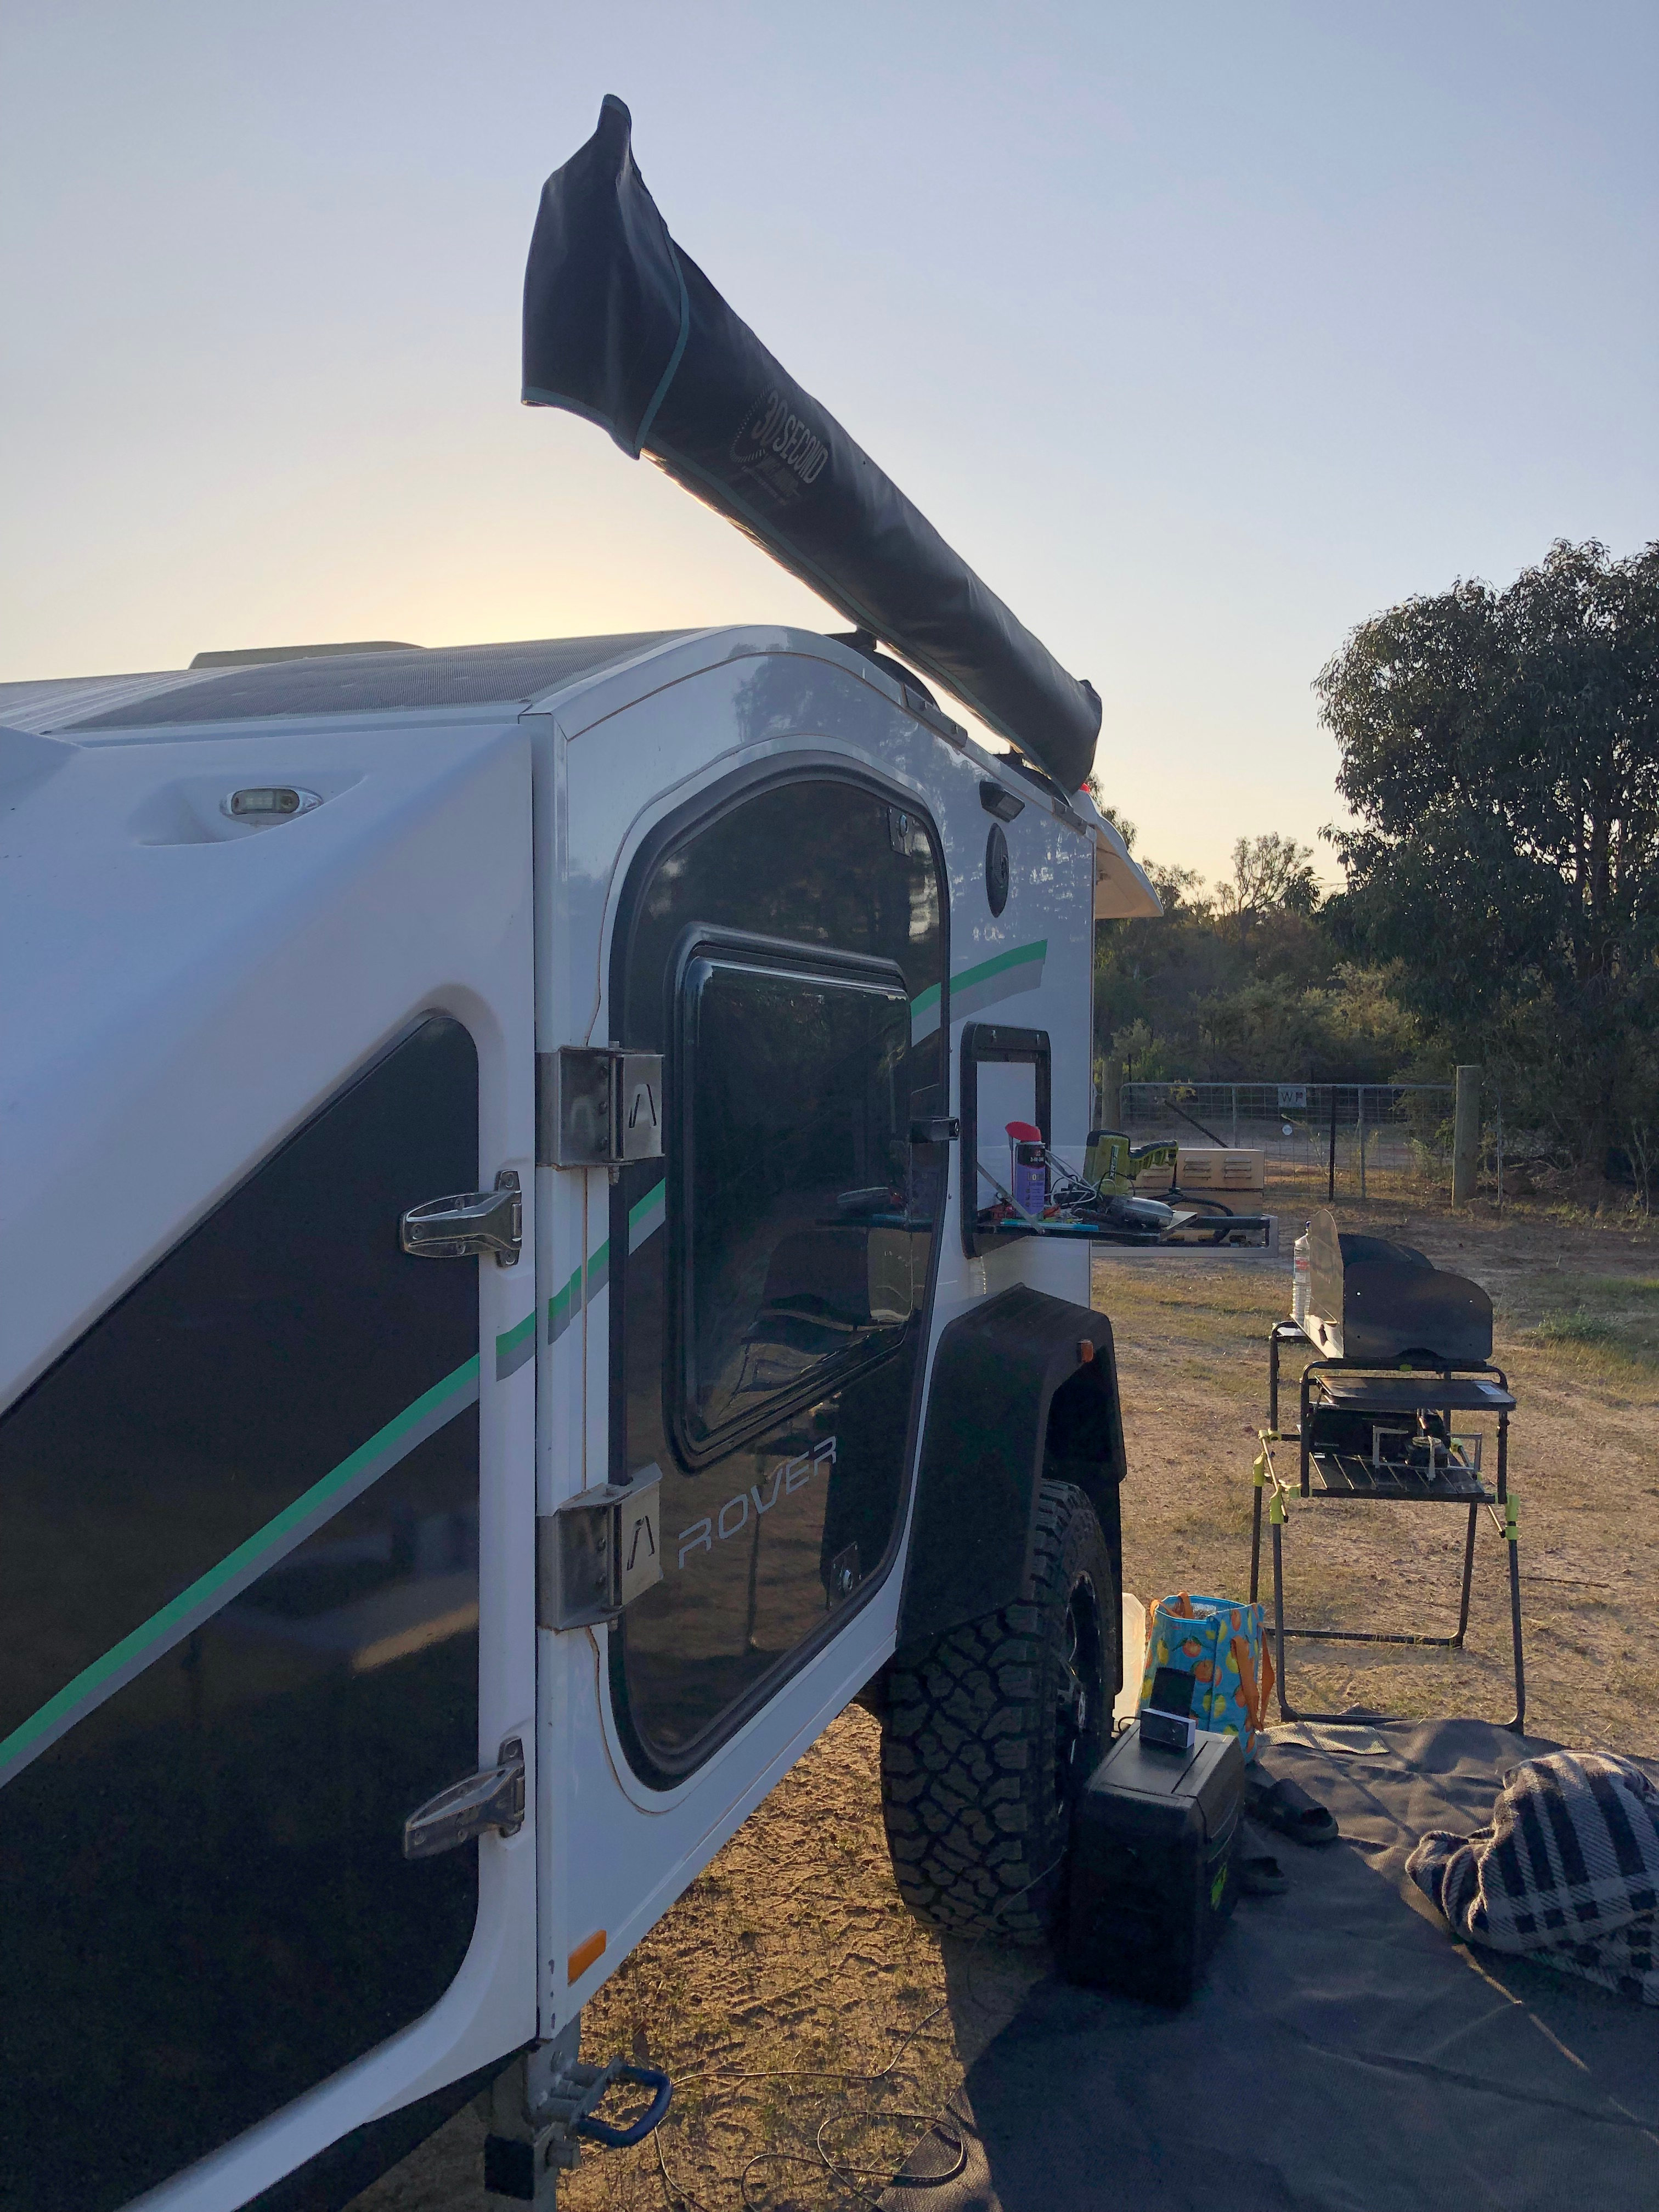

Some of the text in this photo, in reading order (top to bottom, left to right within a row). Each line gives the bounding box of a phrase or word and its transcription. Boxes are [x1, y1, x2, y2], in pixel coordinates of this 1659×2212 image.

[751, 390, 788, 446] 30
[772, 414, 828, 484] SECOND
[678, 1435, 837, 1570] ROVER
